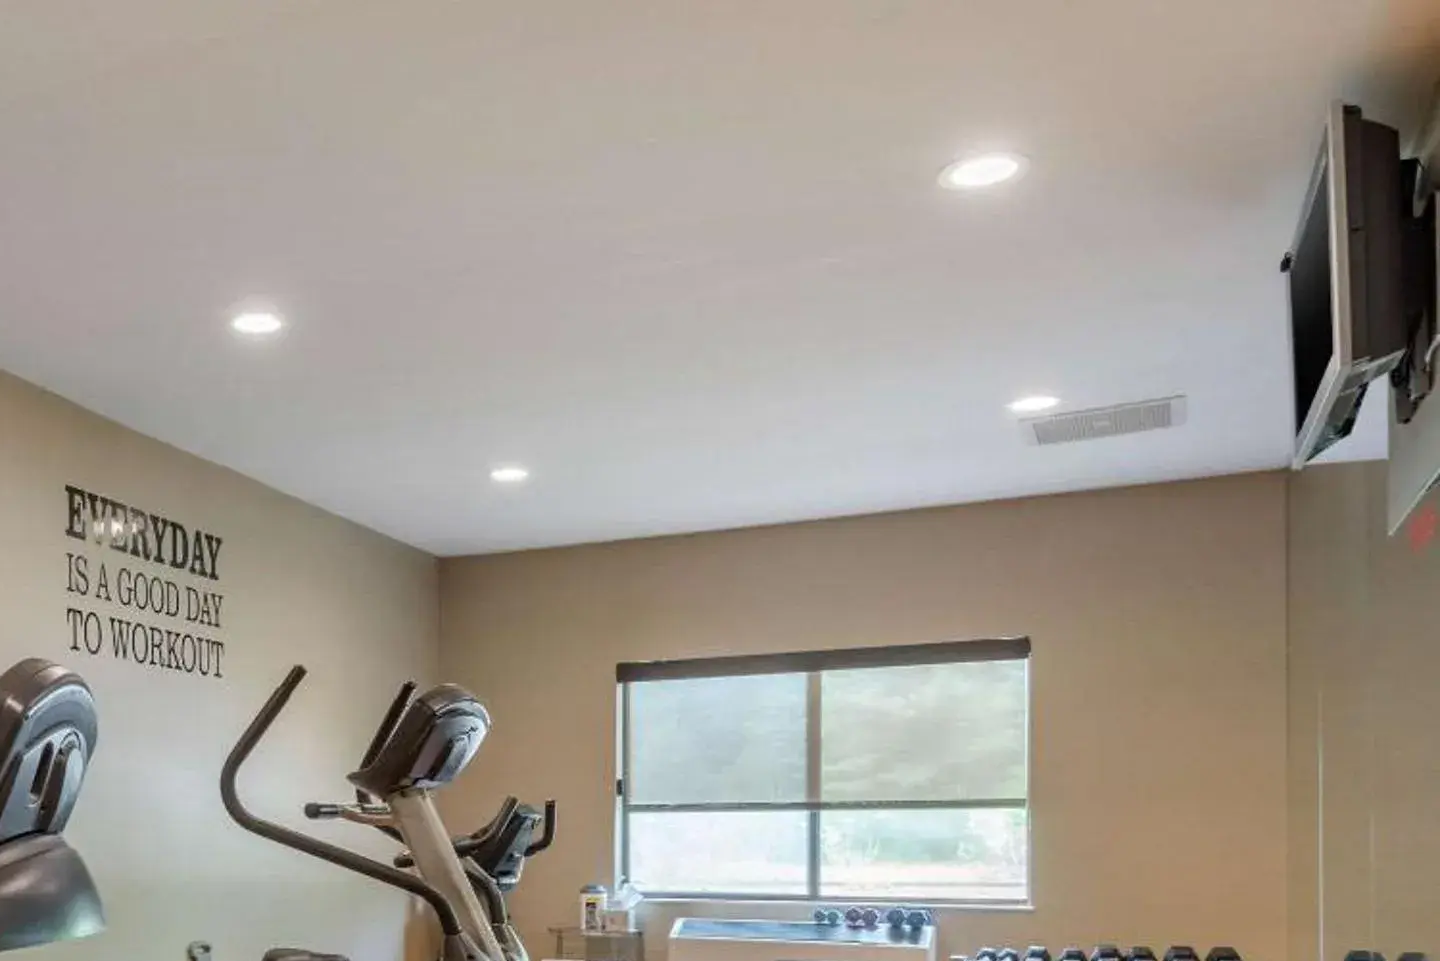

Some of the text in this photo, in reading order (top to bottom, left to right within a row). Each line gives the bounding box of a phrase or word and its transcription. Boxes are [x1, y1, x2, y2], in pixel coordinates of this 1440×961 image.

[65, 484, 222, 581] EVERYDAY
[66, 552, 223, 628] IS A GOOD DAY
[66, 608, 225, 678] TO WORKOUT
